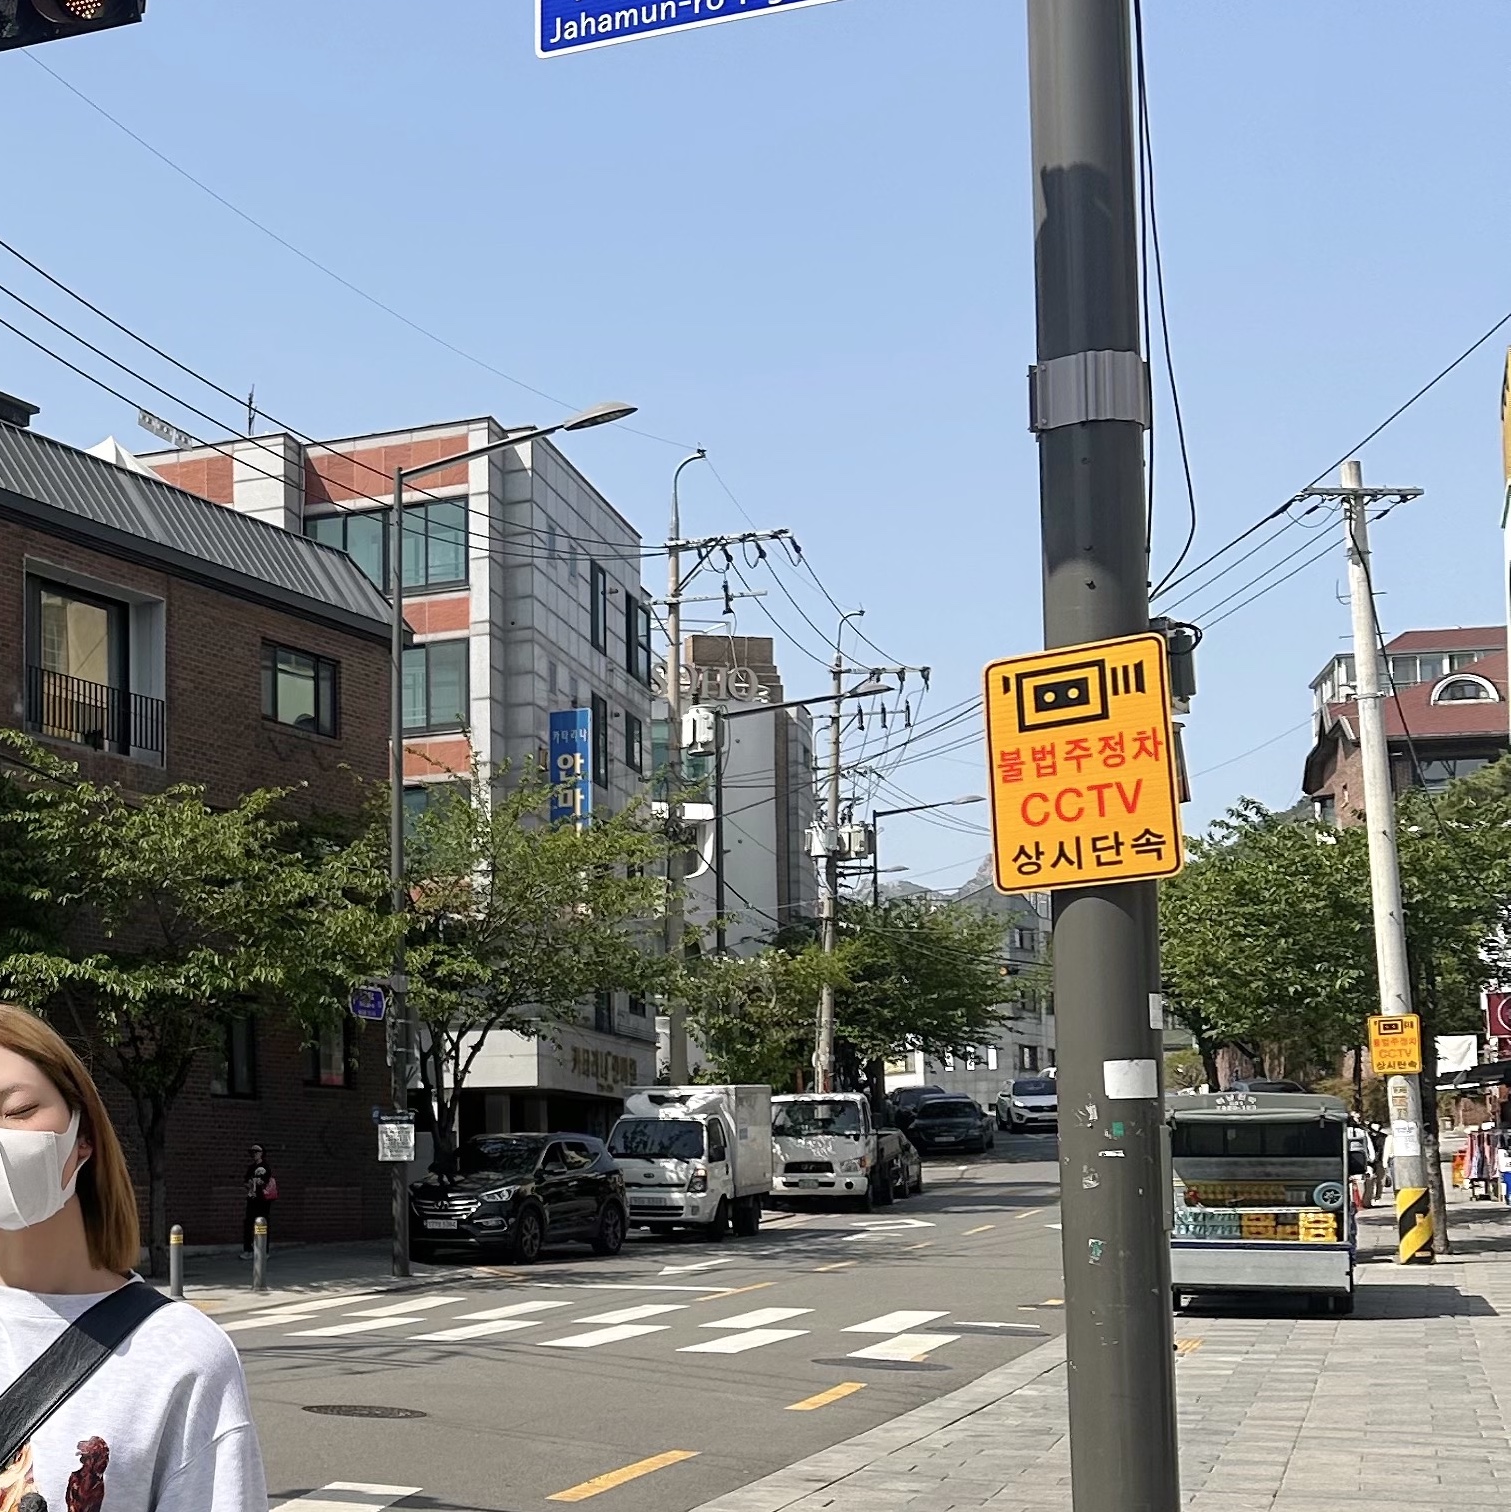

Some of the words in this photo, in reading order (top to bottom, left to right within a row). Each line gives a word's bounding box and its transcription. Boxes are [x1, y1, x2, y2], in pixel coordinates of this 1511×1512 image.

[998, 727, 1163, 784] 불법주정차
[1021, 778, 1143, 827] CCTV
[1012, 828, 1166, 875] 상시단속
[1379, 1048, 1412, 1058] CCTV
